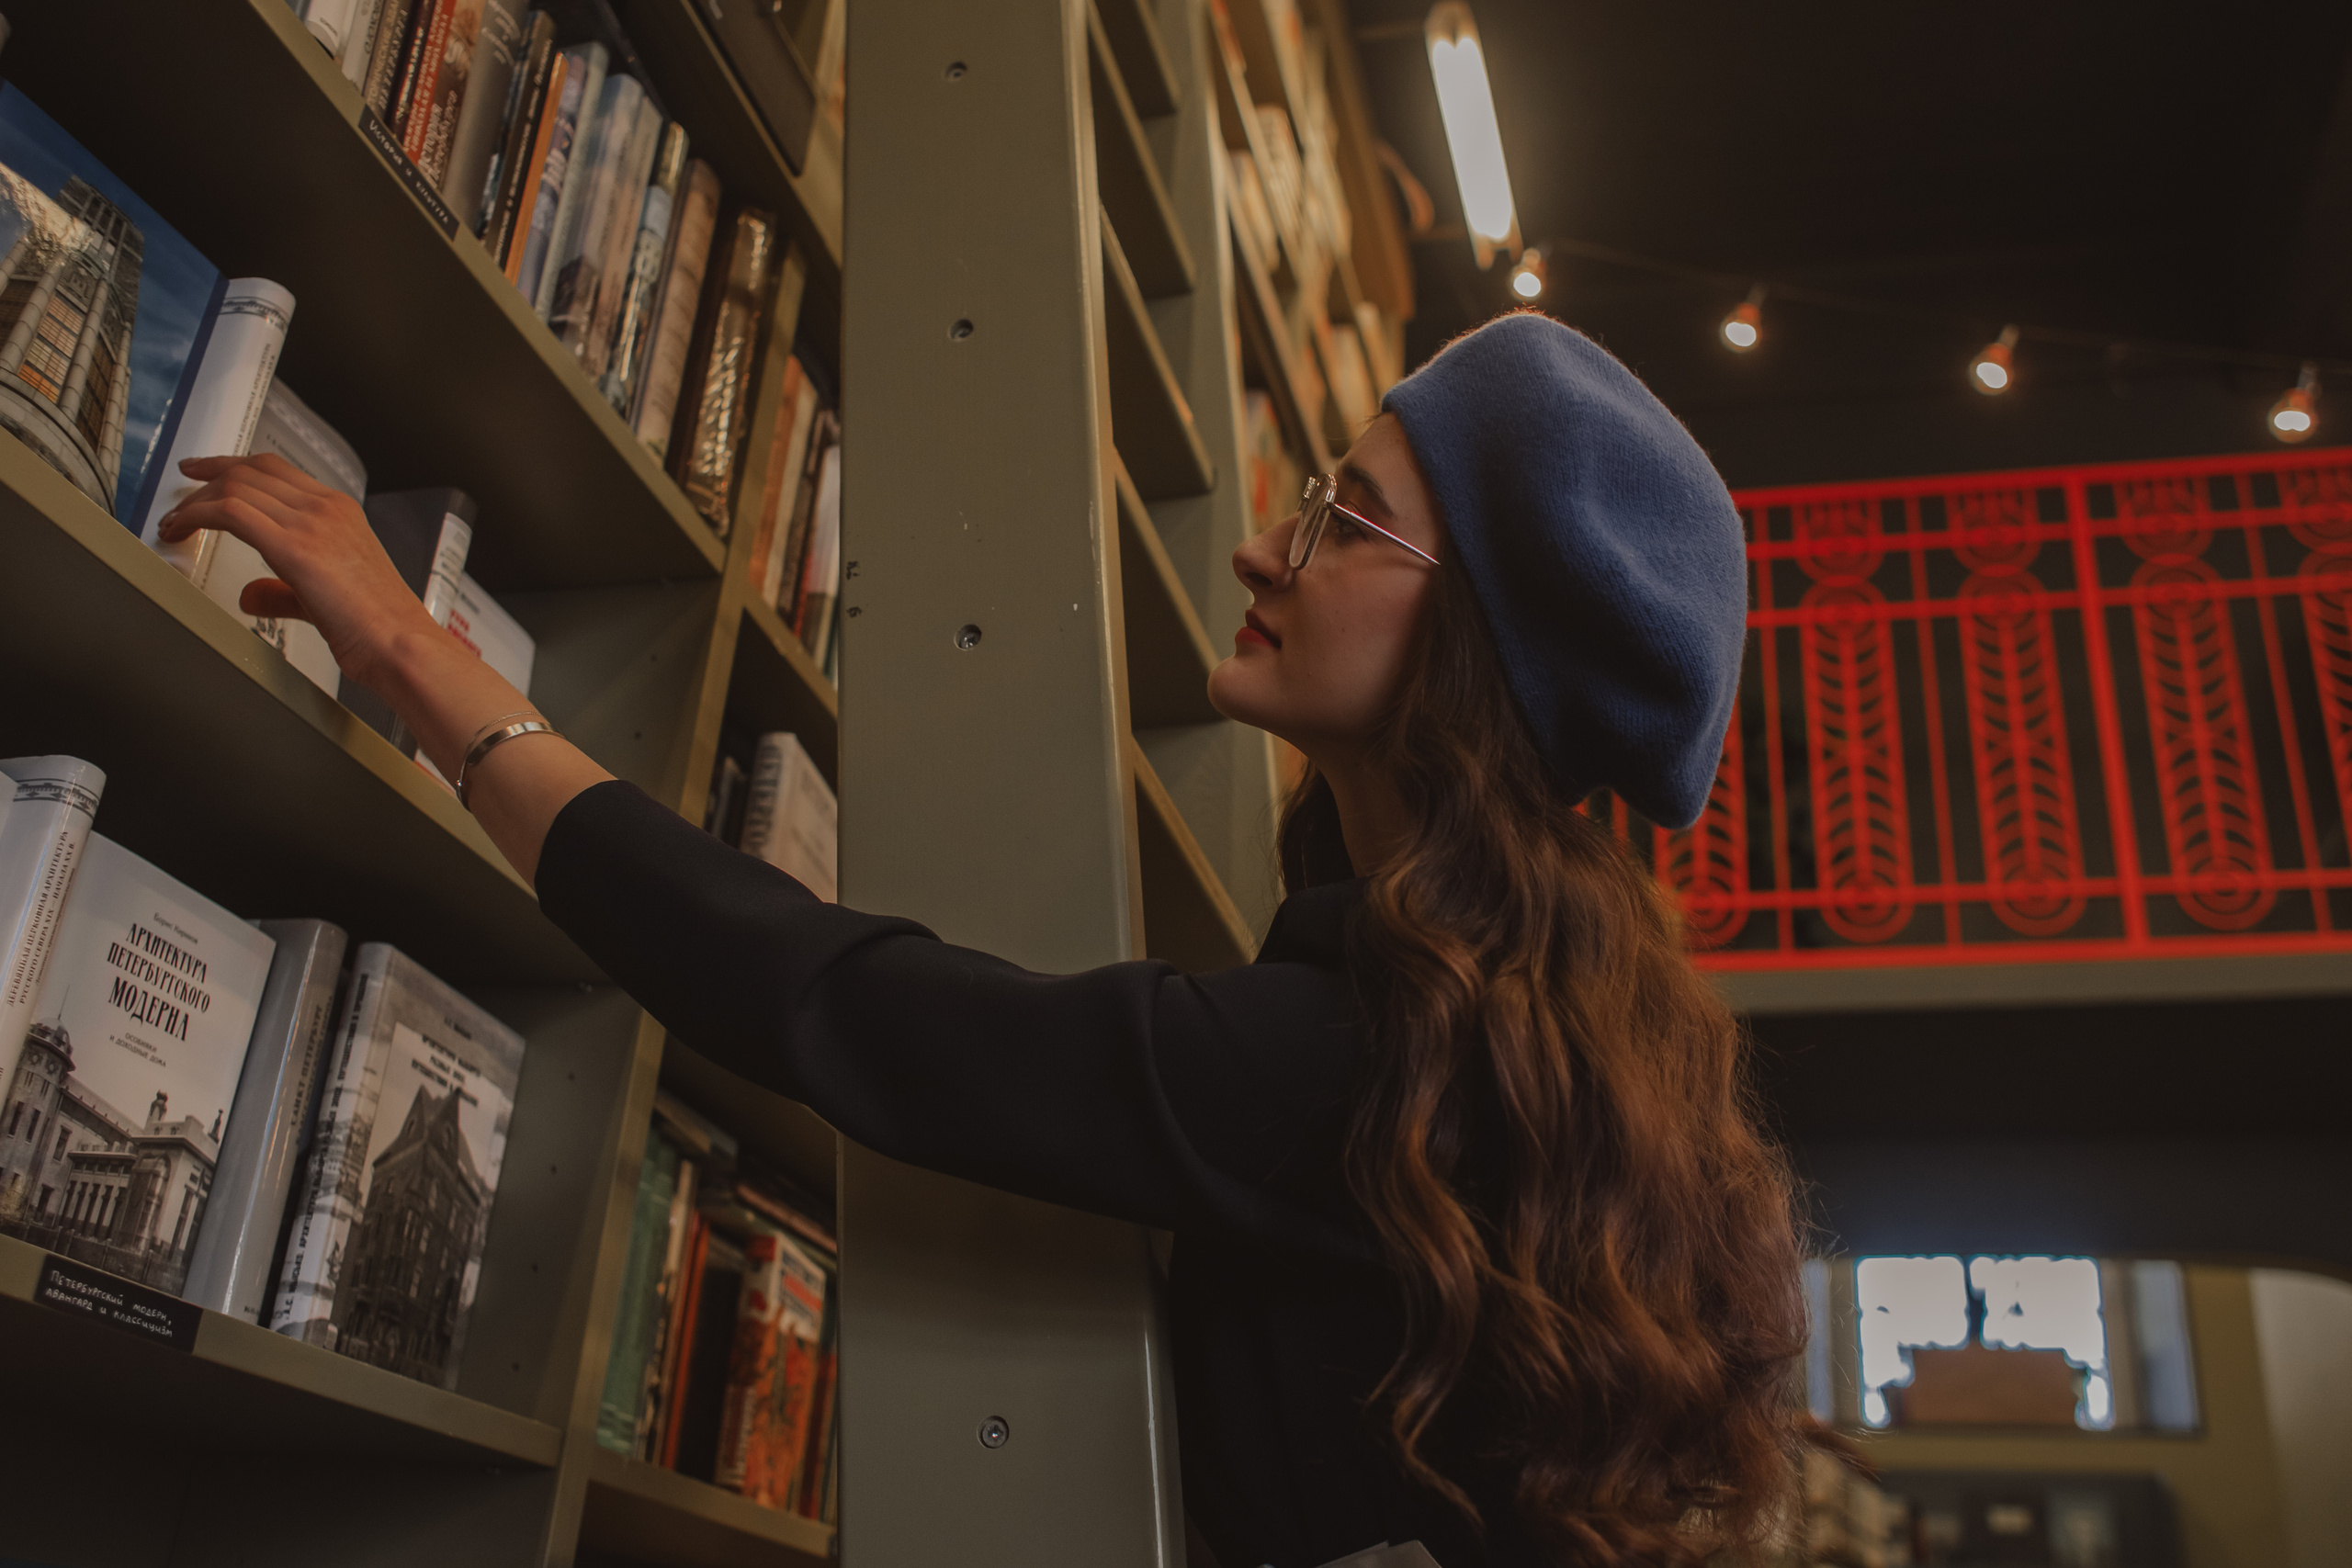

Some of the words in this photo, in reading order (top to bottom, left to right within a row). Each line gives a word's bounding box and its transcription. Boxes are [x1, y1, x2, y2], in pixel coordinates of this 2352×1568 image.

[27, 893, 48, 950] ЦЕРКОВНАЯ
[44, 831, 68, 892] АРХИТЕКТУРА
[19, 959, 40, 1005] РУССКОГО
[107, 942, 211, 1014] ПЕТЕРБУРГСКОГО
[126, 922, 208, 984] АРХИТЕКТУРА
[108, 976, 190, 1042] МОДЕРНА
[46, 1288, 93, 1311] АВАНГАРД
[114, 1310, 173, 1337] КЛАССИЦИЗМ
[51, 1269, 124, 1306] ПЕТЕРБУРГСКИЙ
